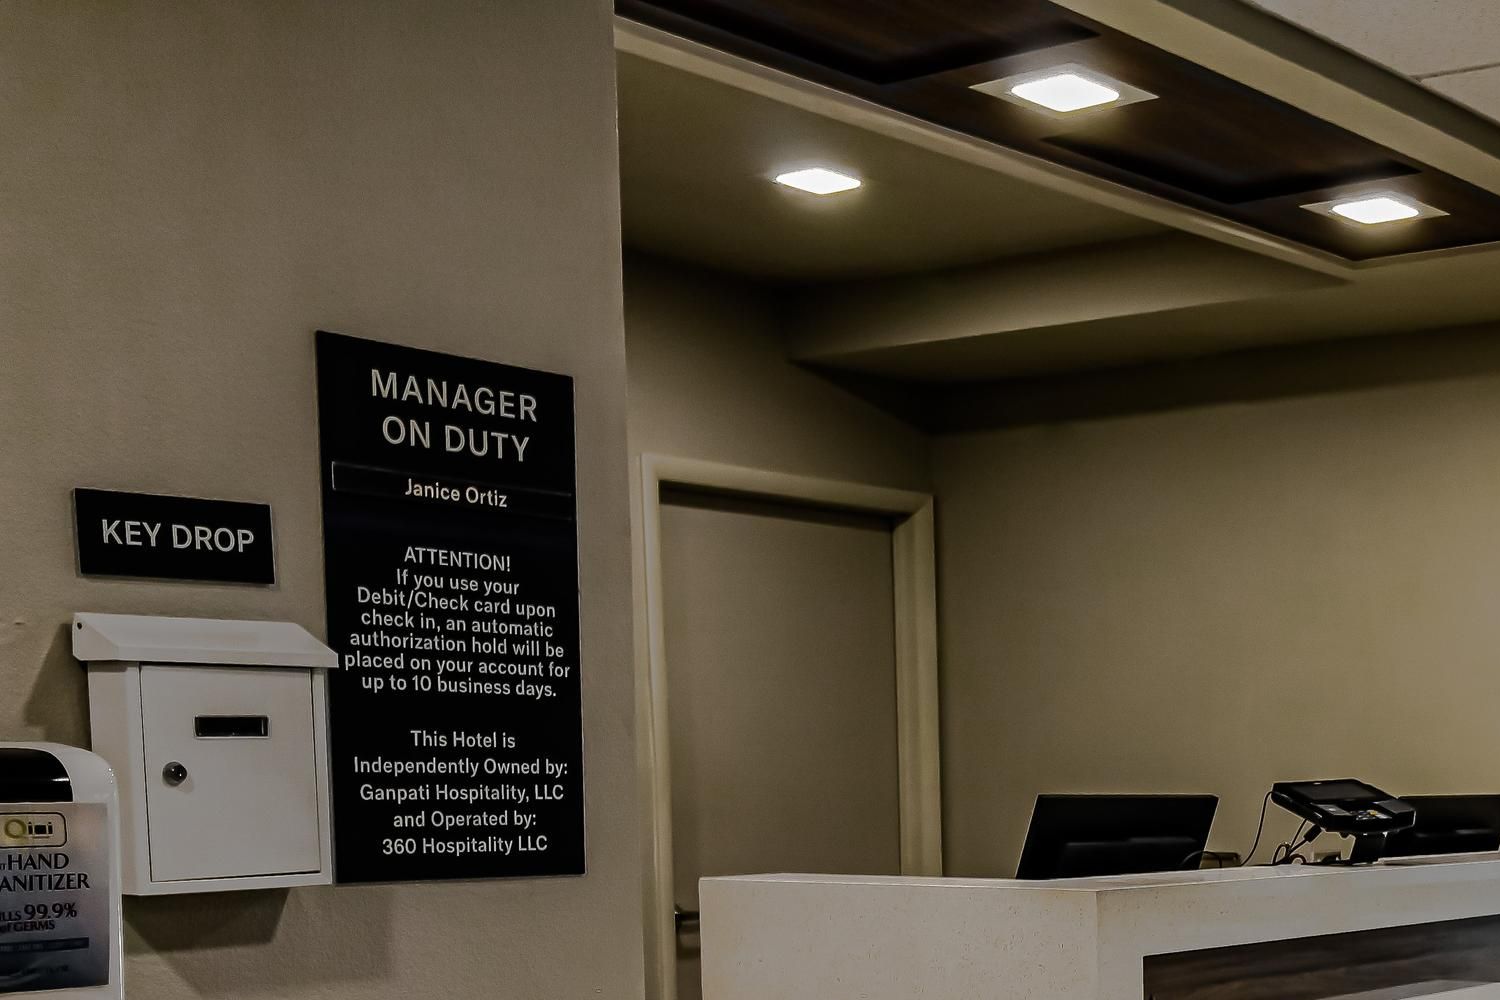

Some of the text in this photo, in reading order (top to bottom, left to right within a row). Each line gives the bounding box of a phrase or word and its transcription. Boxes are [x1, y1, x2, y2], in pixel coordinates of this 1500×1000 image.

[371, 368, 537, 422] MANAGER
[382, 415, 530, 462] ON DUTY
[405, 478, 507, 507] Janice Ortiz
[102, 519, 254, 552] KEY DROP
[404, 546, 511, 572] ATTENTION!
[396, 568, 519, 597] If you use your
[357, 586, 556, 620] Debit/Check card upon
[361, 608, 553, 638] check in, an automatic
[350, 630, 564, 658] authorization hold will be
[344, 650, 570, 678] placed on your account for
[362, 674, 557, 700] up to 10 business days.
[410, 730, 516, 748] This Hotel is
[354, 756, 568, 778] Independently Owned by:
[360, 784, 564, 804] Ganpati Hospitality, LLC
[393, 810, 537, 831] and Operated by:
[382, 835, 548, 857] 360 Hospitality LLC
[8, 853, 69, 871] HAND
[0, 873, 90, 893] ANITIZER
[24, 902, 77, 919] 99.9%
